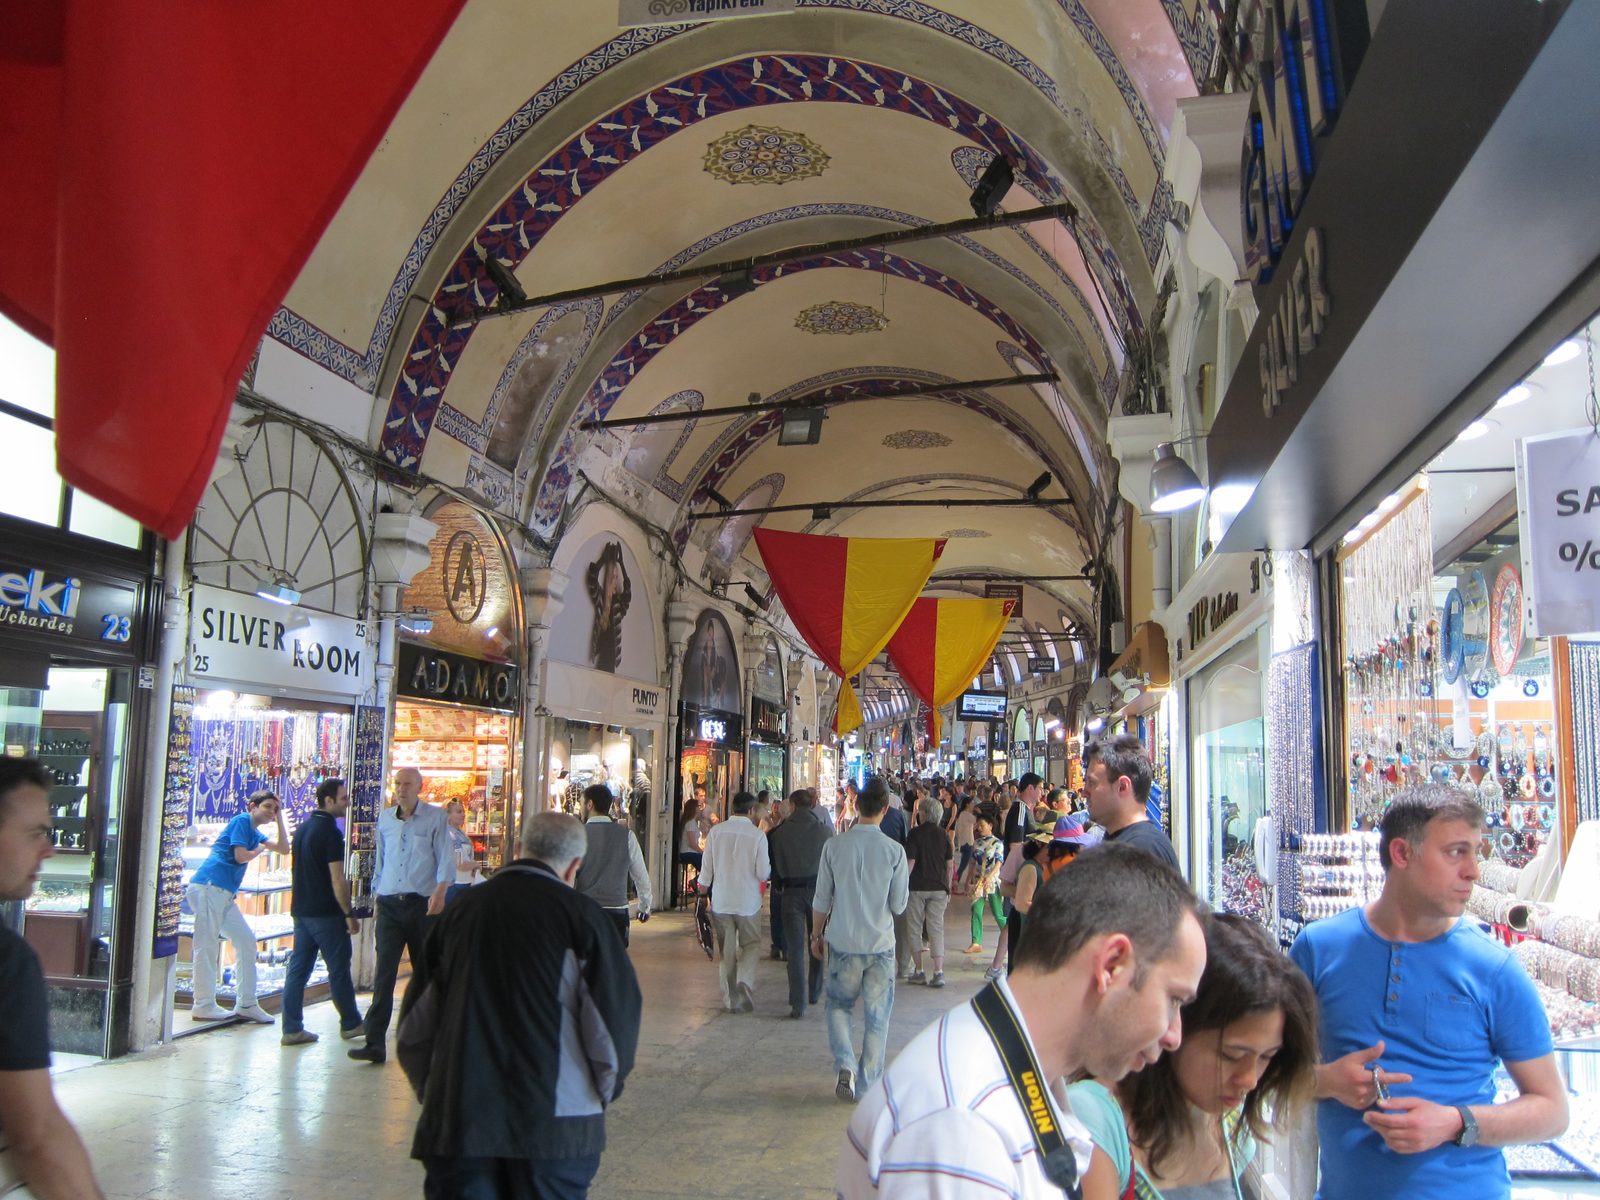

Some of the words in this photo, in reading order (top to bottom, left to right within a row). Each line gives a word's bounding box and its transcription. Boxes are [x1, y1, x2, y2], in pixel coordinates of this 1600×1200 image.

[102, 614, 131, 641] 23
[355, 623, 366, 638] 25
[203, 608, 286, 651] SILVER
[293, 639, 360, 677] ROOM
[194, 655, 209, 672] 25
[411, 656, 508, 702] ADAMO
[632, 688, 658, 707] PUNTO
[1021, 1071, 1053, 1134] Nikon
